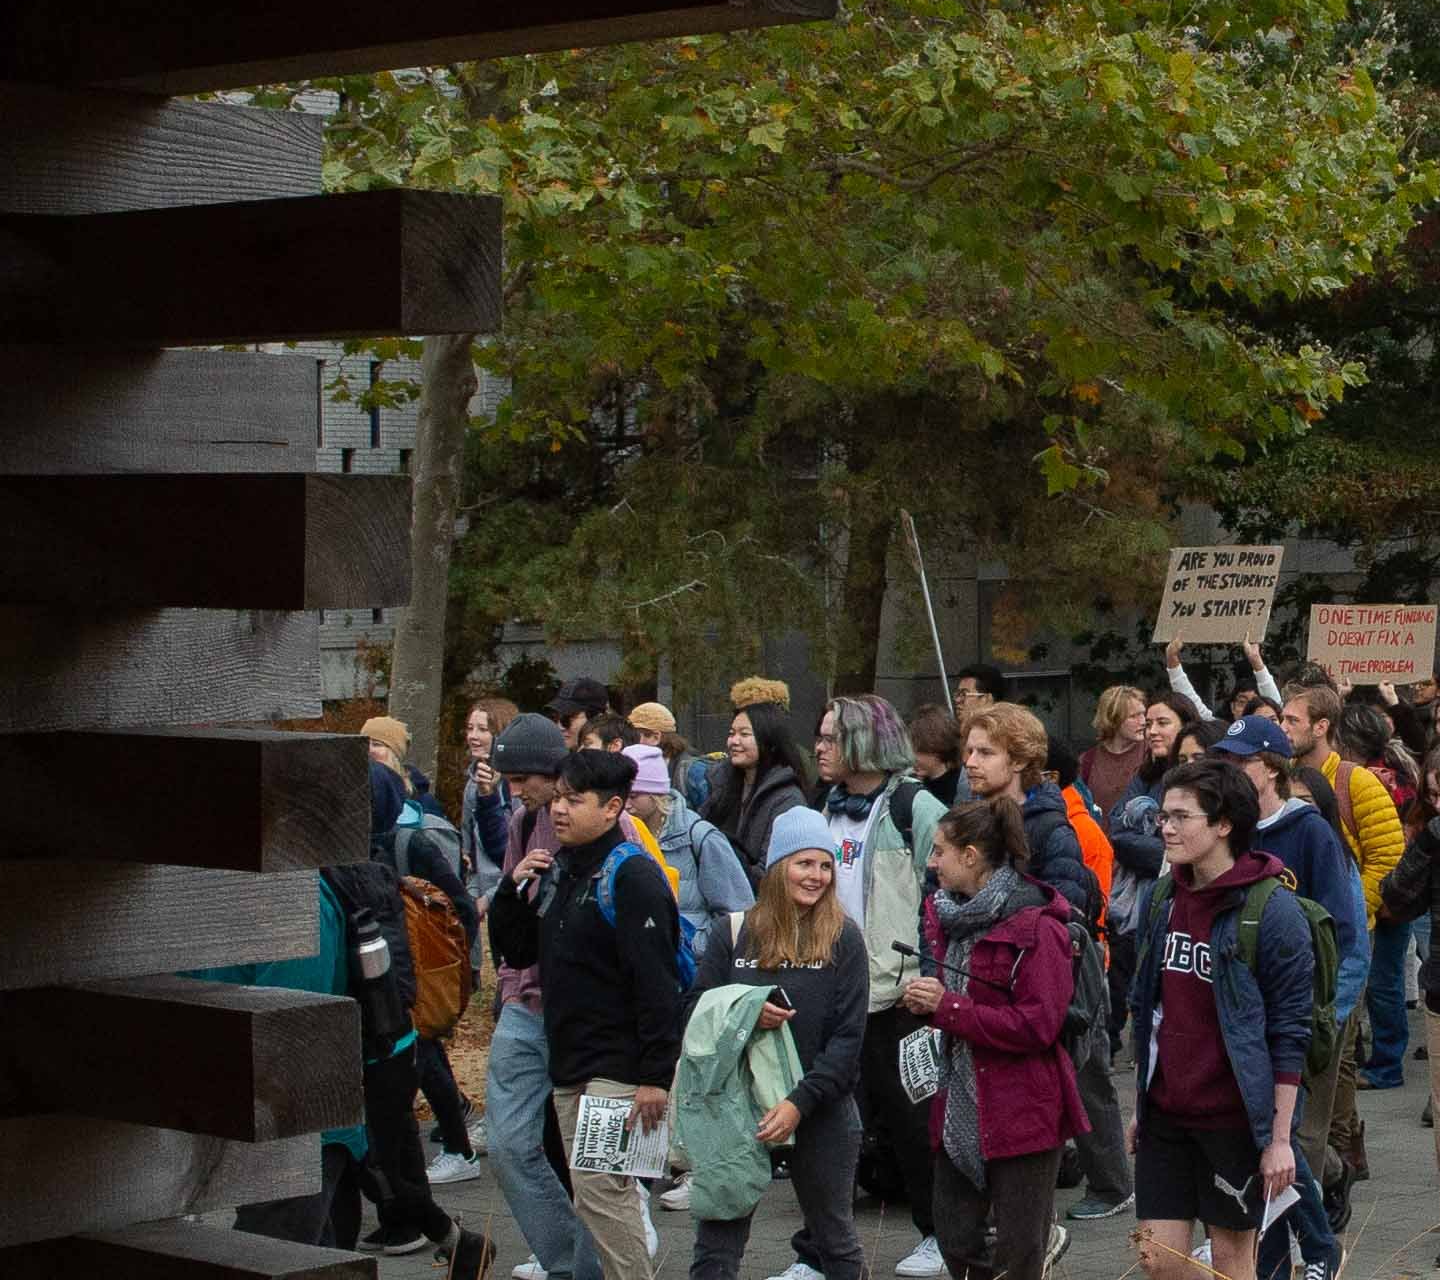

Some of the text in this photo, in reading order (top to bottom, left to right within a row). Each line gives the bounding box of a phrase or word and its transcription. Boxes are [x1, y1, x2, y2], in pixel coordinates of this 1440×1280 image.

[1177, 551, 1275, 571] ARE YOU PROUD
[1172, 577, 1191, 592] OF
[1219, 572, 1276, 589] STUDENTS
[1171, 598, 1266, 618] YOU STARVE?
[1319, 608, 1435, 625] ONE TIME FUNDING
[1376, 630, 1402, 646] FIX
[1404, 631, 1415, 645] A
[1338, 660, 1367, 674] TIME
[1366, 660, 1414, 674] PROBLEM
[586, 1109, 602, 1153] HUNGRY
[602, 1114, 623, 1154] CHANGE
